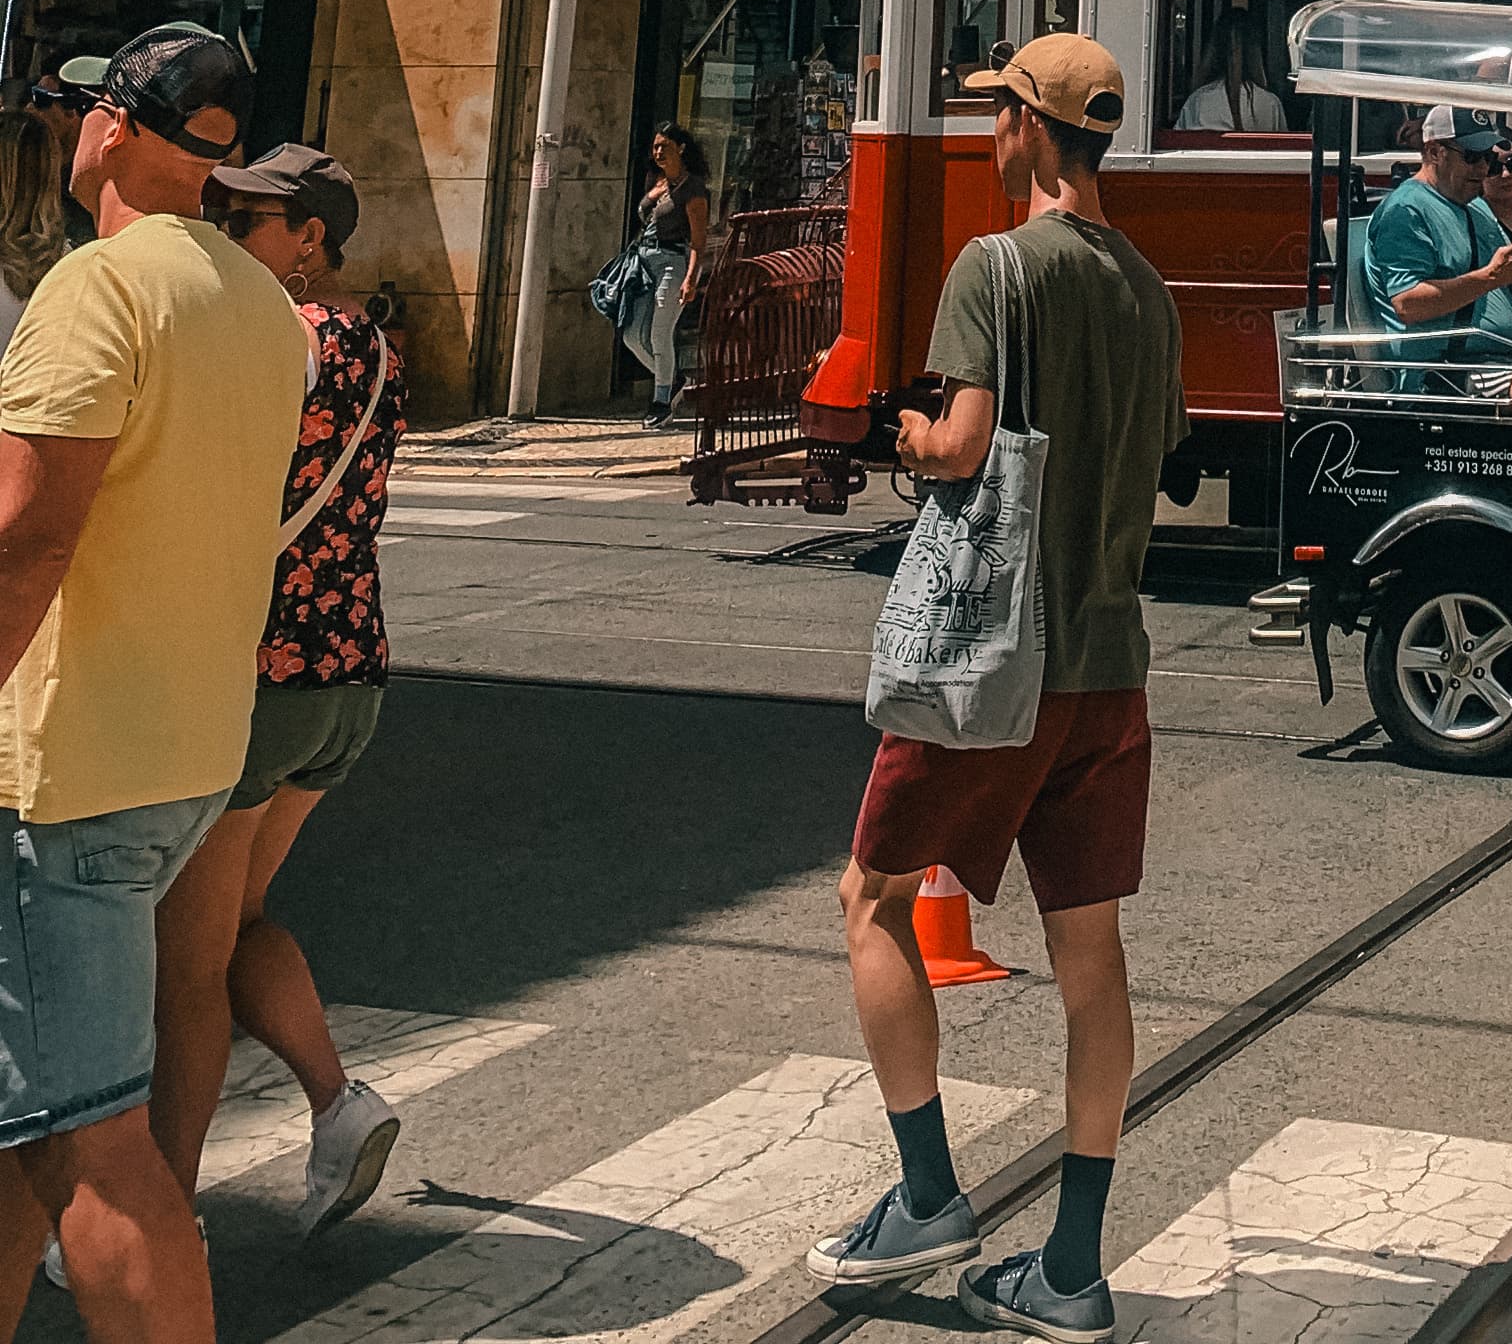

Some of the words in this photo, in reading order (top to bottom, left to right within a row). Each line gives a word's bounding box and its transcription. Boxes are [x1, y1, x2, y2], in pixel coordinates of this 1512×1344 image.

[1425, 445, 1445, 458] real
[1448, 447, 1479, 460] estate
[1424, 460, 1454, 474] +351
[1458, 461, 1479, 474] 913
[1482, 463, 1504, 476] 268
